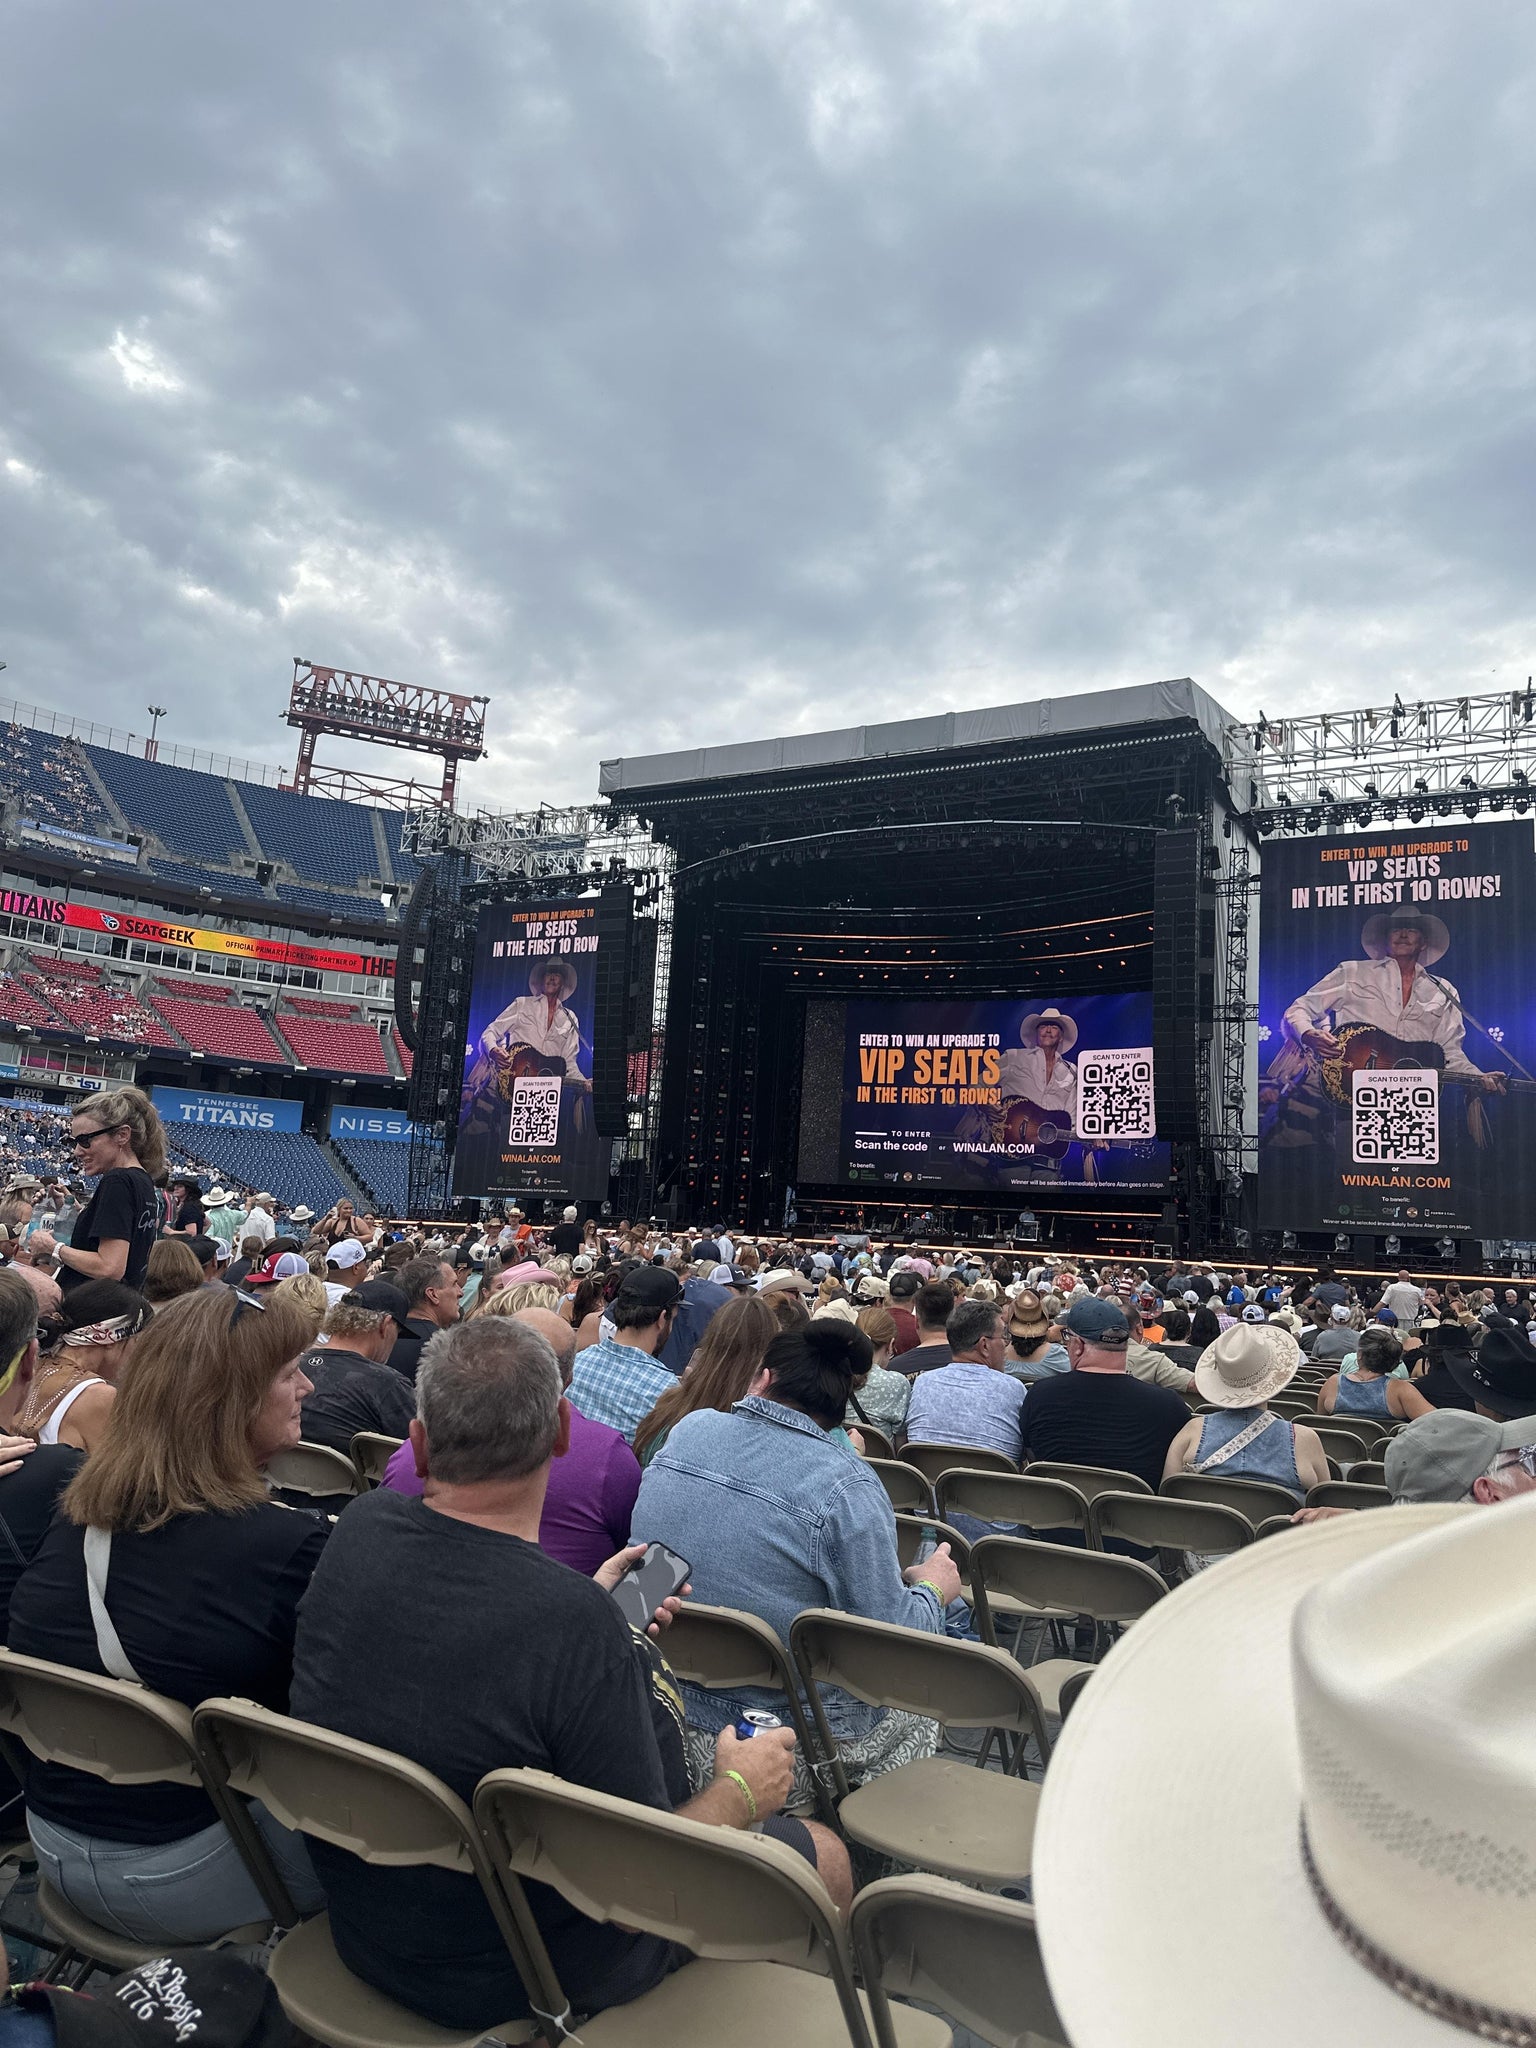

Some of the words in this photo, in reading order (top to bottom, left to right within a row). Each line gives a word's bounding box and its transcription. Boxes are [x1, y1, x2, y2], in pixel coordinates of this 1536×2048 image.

[1321, 849, 1350, 861] ENTER
[1353, 847, 1364, 859] TO
[1368, 846, 1387, 858] WIN
[1390, 845, 1404, 856] AN
[1407, 841, 1453, 855] UPGRADE
[1455, 840, 1468, 851] TO
[1347, 859, 1378, 882] VIP
[1383, 855, 1440, 880] SEATS
[1291, 888, 1310, 909] IN
[1315, 885, 1348, 907] THE
[1354, 880, 1405, 905] FIRST
[1409, 880, 1431, 902] 10
[1438, 874, 1501, 900] ROWS!
[512, 913, 529, 923] ENTER
[530, 912, 537, 922] TO
[538, 912, 548, 921] WIN
[550, 911, 559, 920] AN
[560, 909, 586, 920] UPGRADE
[587, 908, 594, 918] TO
[0, 889, 66, 924] TITANS
[125, 919, 195, 946] SEATGEEK
[225, 940, 255, 952] OFFICIAL
[255, 945, 286, 957] PRIMARY
[319, 956, 348, 967] PARTNER
[348, 960, 358, 968] OF
[360, 955, 395, 978] THE
[526, 922, 542, 938] VIP
[545, 920, 578, 937] SEATS
[492, 941, 504, 958] IN
[506, 940, 526, 957] THE
[528, 938, 556, 956] FIRST
[558, 937, 571, 954] 10
[859, 1034, 888, 1047] ENTER
[891, 1034, 903, 1047] TO
[906, 1034, 925, 1047] WIN
[926, 1034, 940, 1047] AN
[942, 1034, 986, 1047] UPGRADE
[988, 1033, 1000, 1047] TO
[1121, 1052, 1142, 1060] ENTER
[859, 1048, 905, 1084] VIP
[913, 1048, 1001, 1085] SEATS
[14, 1086, 44, 1098] FLOYD
[856, 1086, 870, 1103] IN
[874, 1086, 898, 1104] THE
[901, 1087, 937, 1105] FIRST
[940, 1088, 956, 1105] 10
[959, 1087, 1002, 1106] ROWS!
[38, 1104, 68, 1114] TITANS
[197, 1097, 260, 1111] TENNESSEE
[180, 1103, 275, 1129] TITANS
[339, 1116, 418, 1135] NISSA
[904, 1130, 931, 1138] ENTER
[854, 1139, 881, 1150] Scan
[883, 1140, 900, 1150] the
[902, 1141, 928, 1151] code
[953, 1142, 1035, 1154] WINALAN.COM
[501, 1154, 561, 1164] WINALAN.COM
[1342, 1174, 1451, 1188] WINALAN.COM
[115, 1980, 160, 2021] 1776
